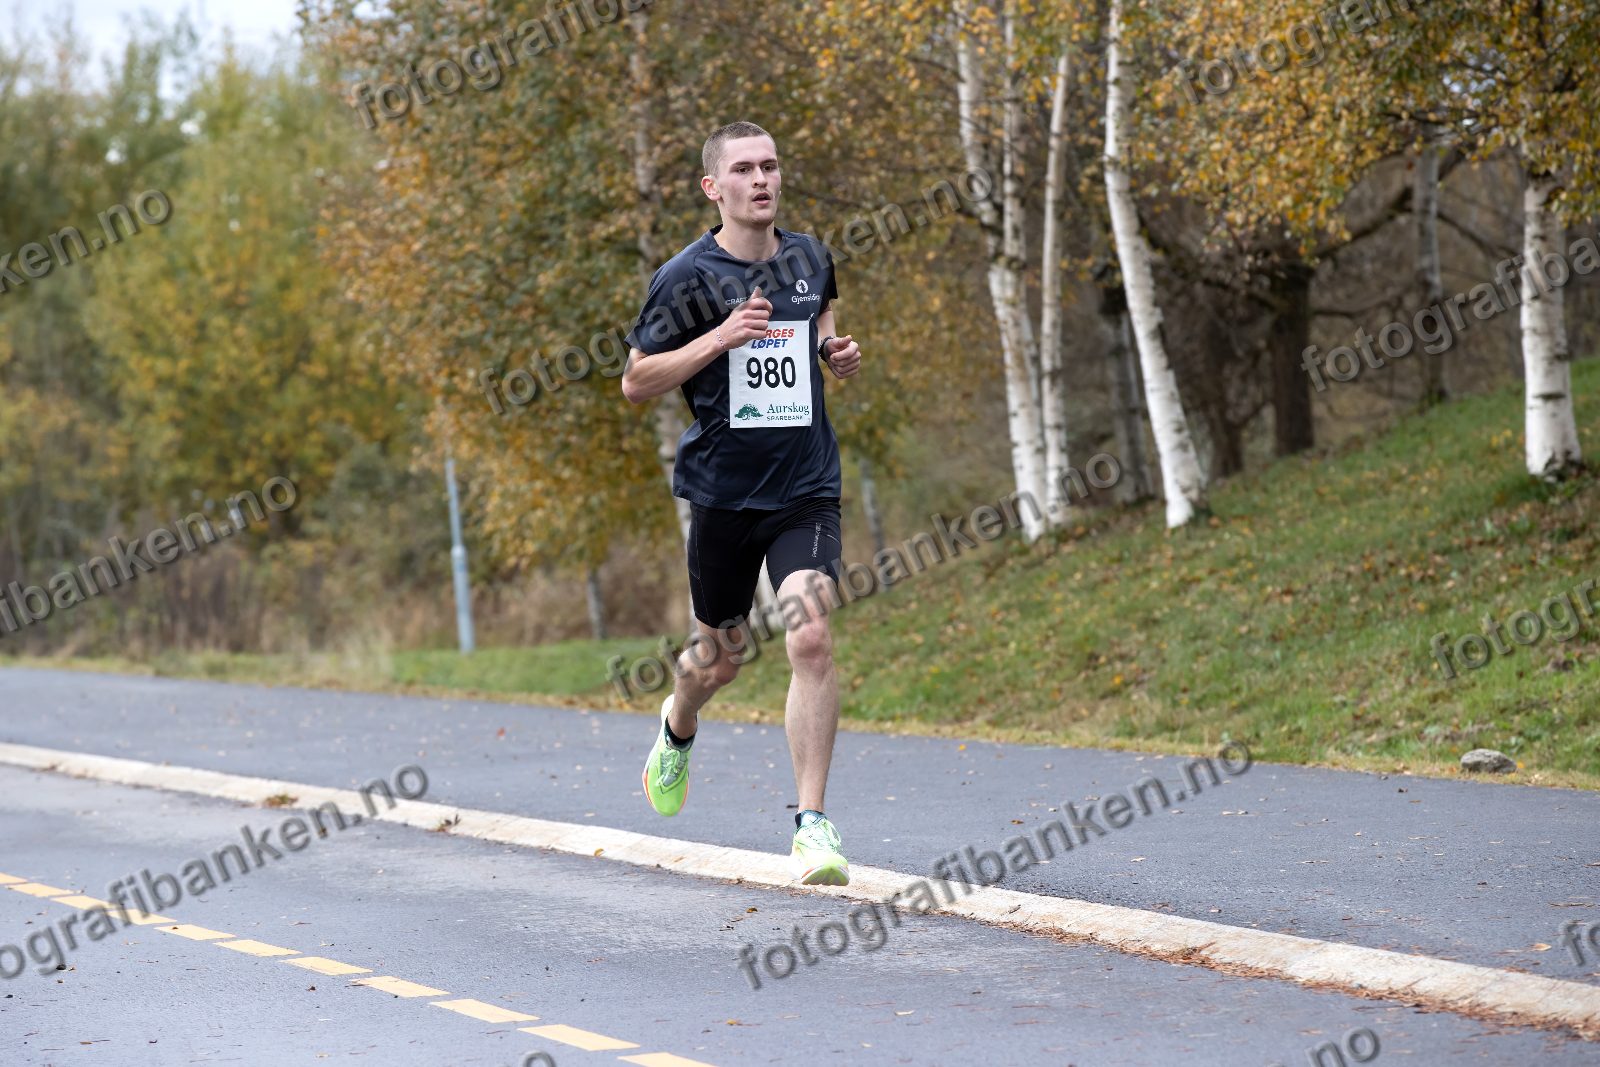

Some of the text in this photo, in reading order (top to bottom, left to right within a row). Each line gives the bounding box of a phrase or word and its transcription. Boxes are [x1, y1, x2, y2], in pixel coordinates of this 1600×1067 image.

[765, 328, 795, 339] RGES
[751, 338, 788, 349] LØPET
[746, 356, 796, 389] 980
[766, 402, 810, 416] Aurskog
